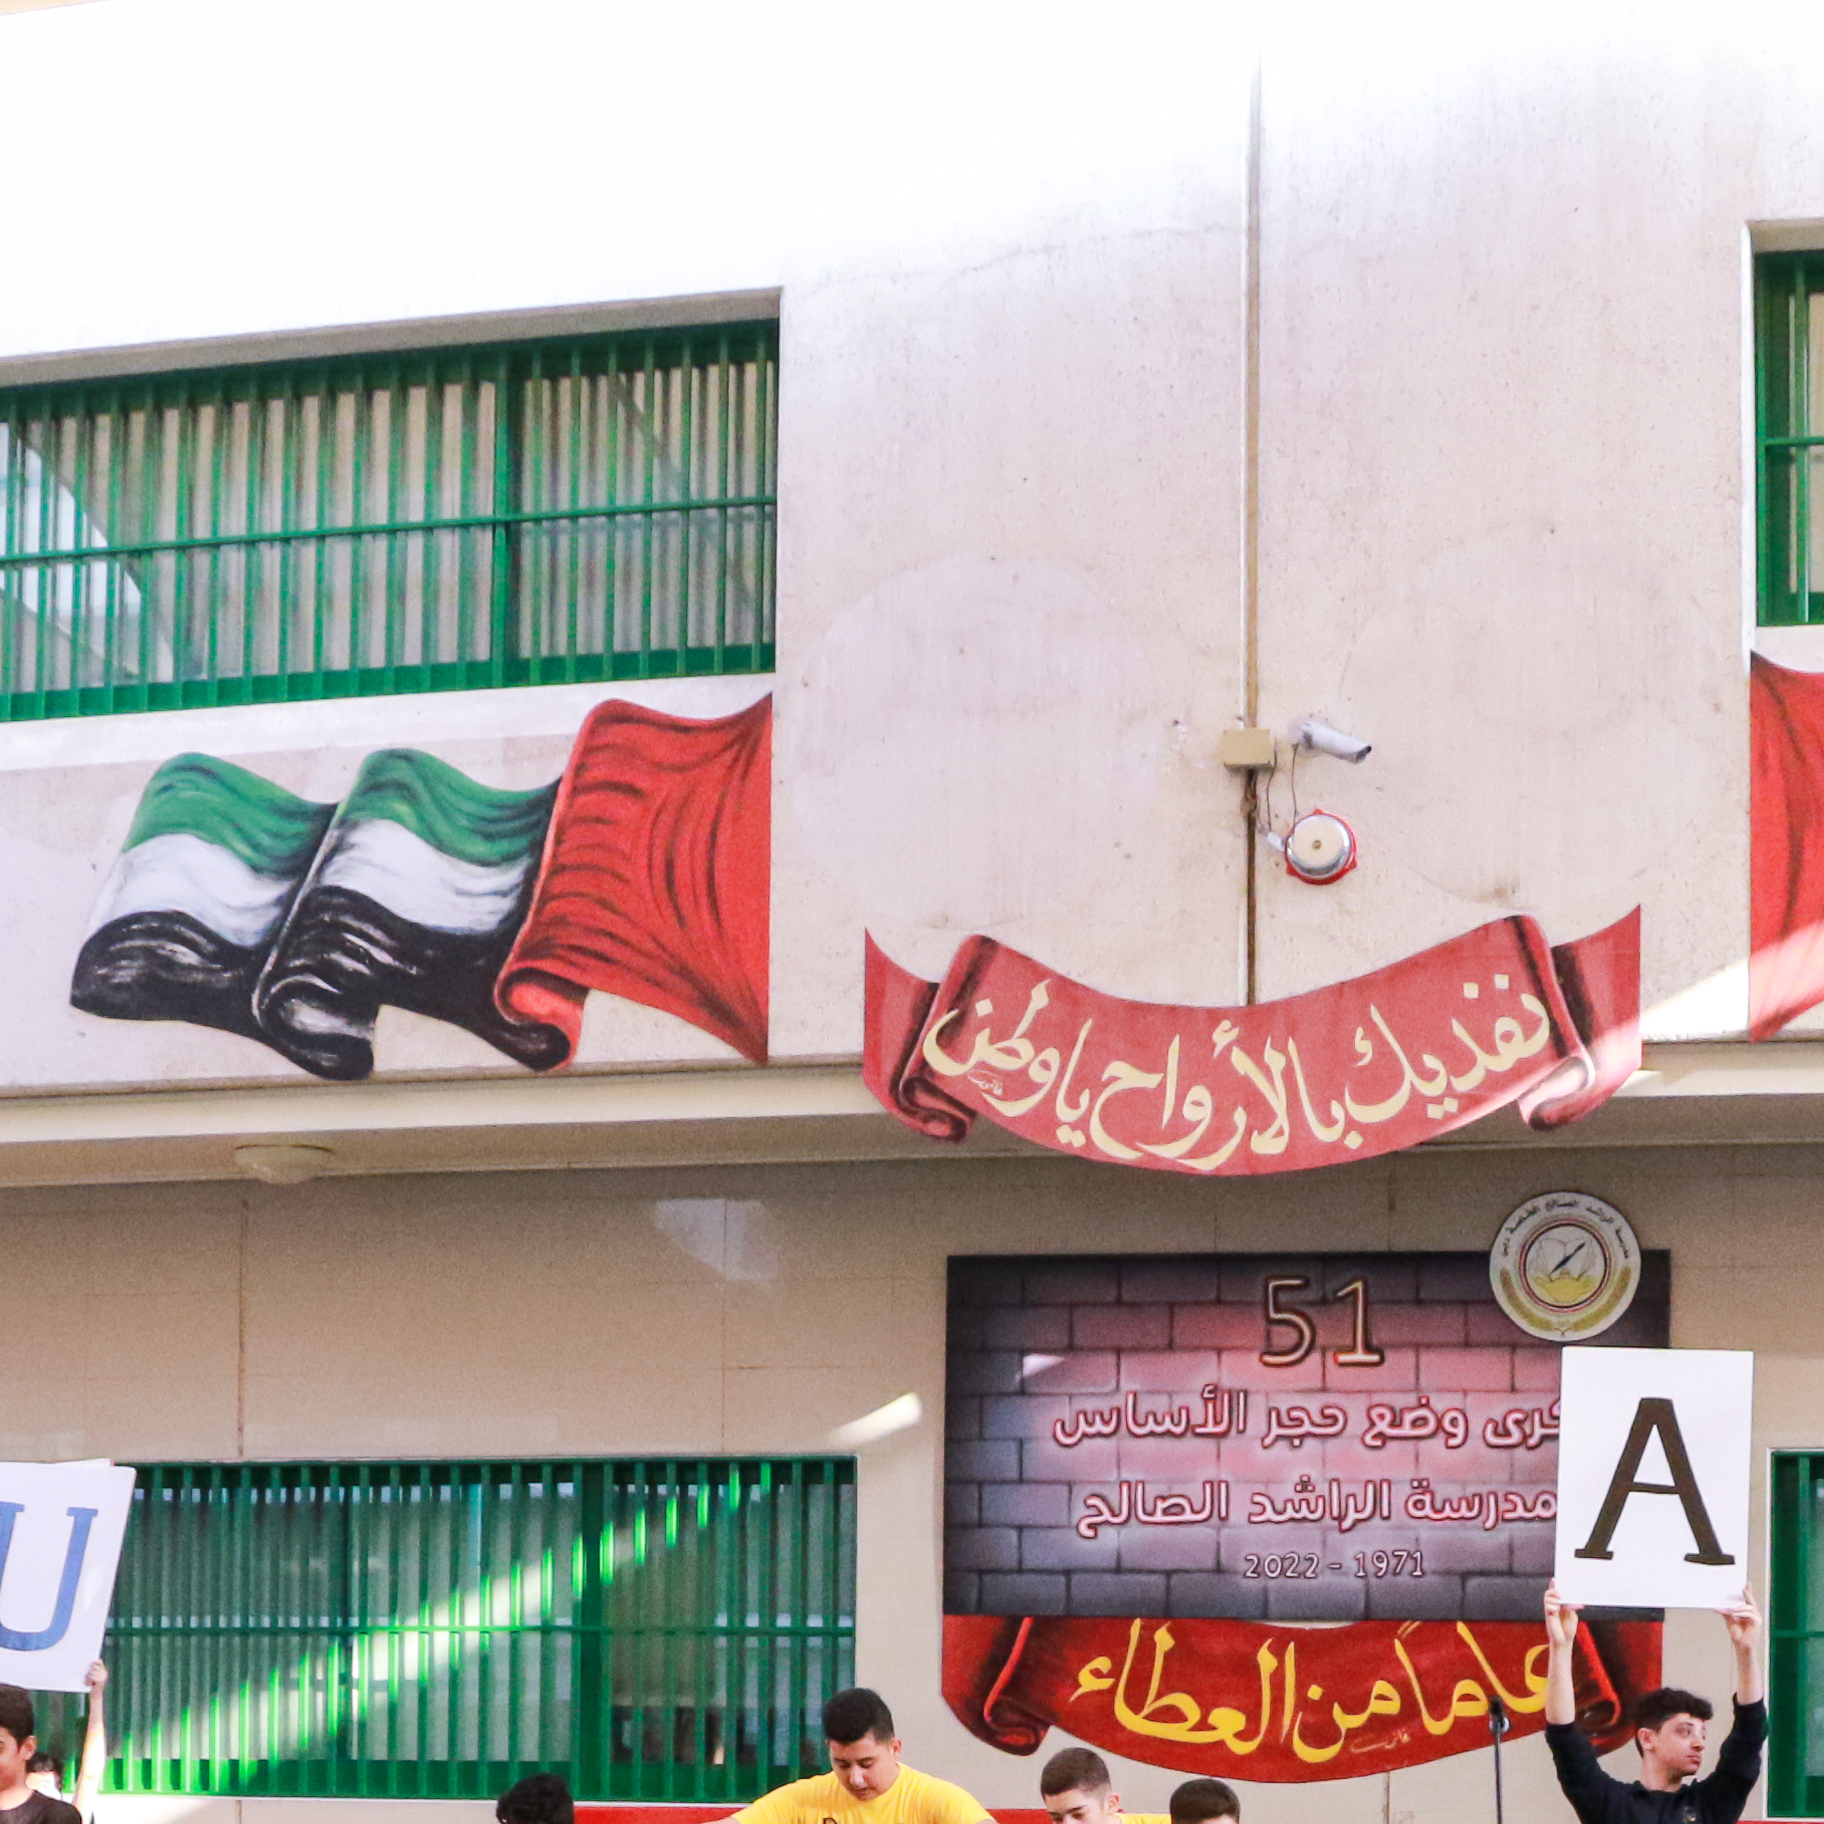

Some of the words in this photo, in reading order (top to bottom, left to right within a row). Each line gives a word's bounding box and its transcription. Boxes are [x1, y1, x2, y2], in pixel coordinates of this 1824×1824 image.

[1344, 972, 1551, 1124] نفديك
[1089, 1018, 1364, 1171] بالأرواح
[1259, 1276, 1384, 1367] 51
[1052, 1383, 1248, 1449] الأساس
[1261, 1400, 1348, 1450] حجر
[1362, 1394, 1469, 1450] وضع
[1076, 1480, 1229, 1539] الصالح
[1248, 1474, 1391, 1534] الراشد
[1404, 1477, 1557, 1532] مدرسة
[1575, 1396, 1736, 1566] A
[1243, 1552, 1321, 1580] 2022
[1354, 1549, 1425, 1578] 1971
[1069, 1617, 1297, 1756] العطاء
[1292, 1679, 1402, 1763] من
